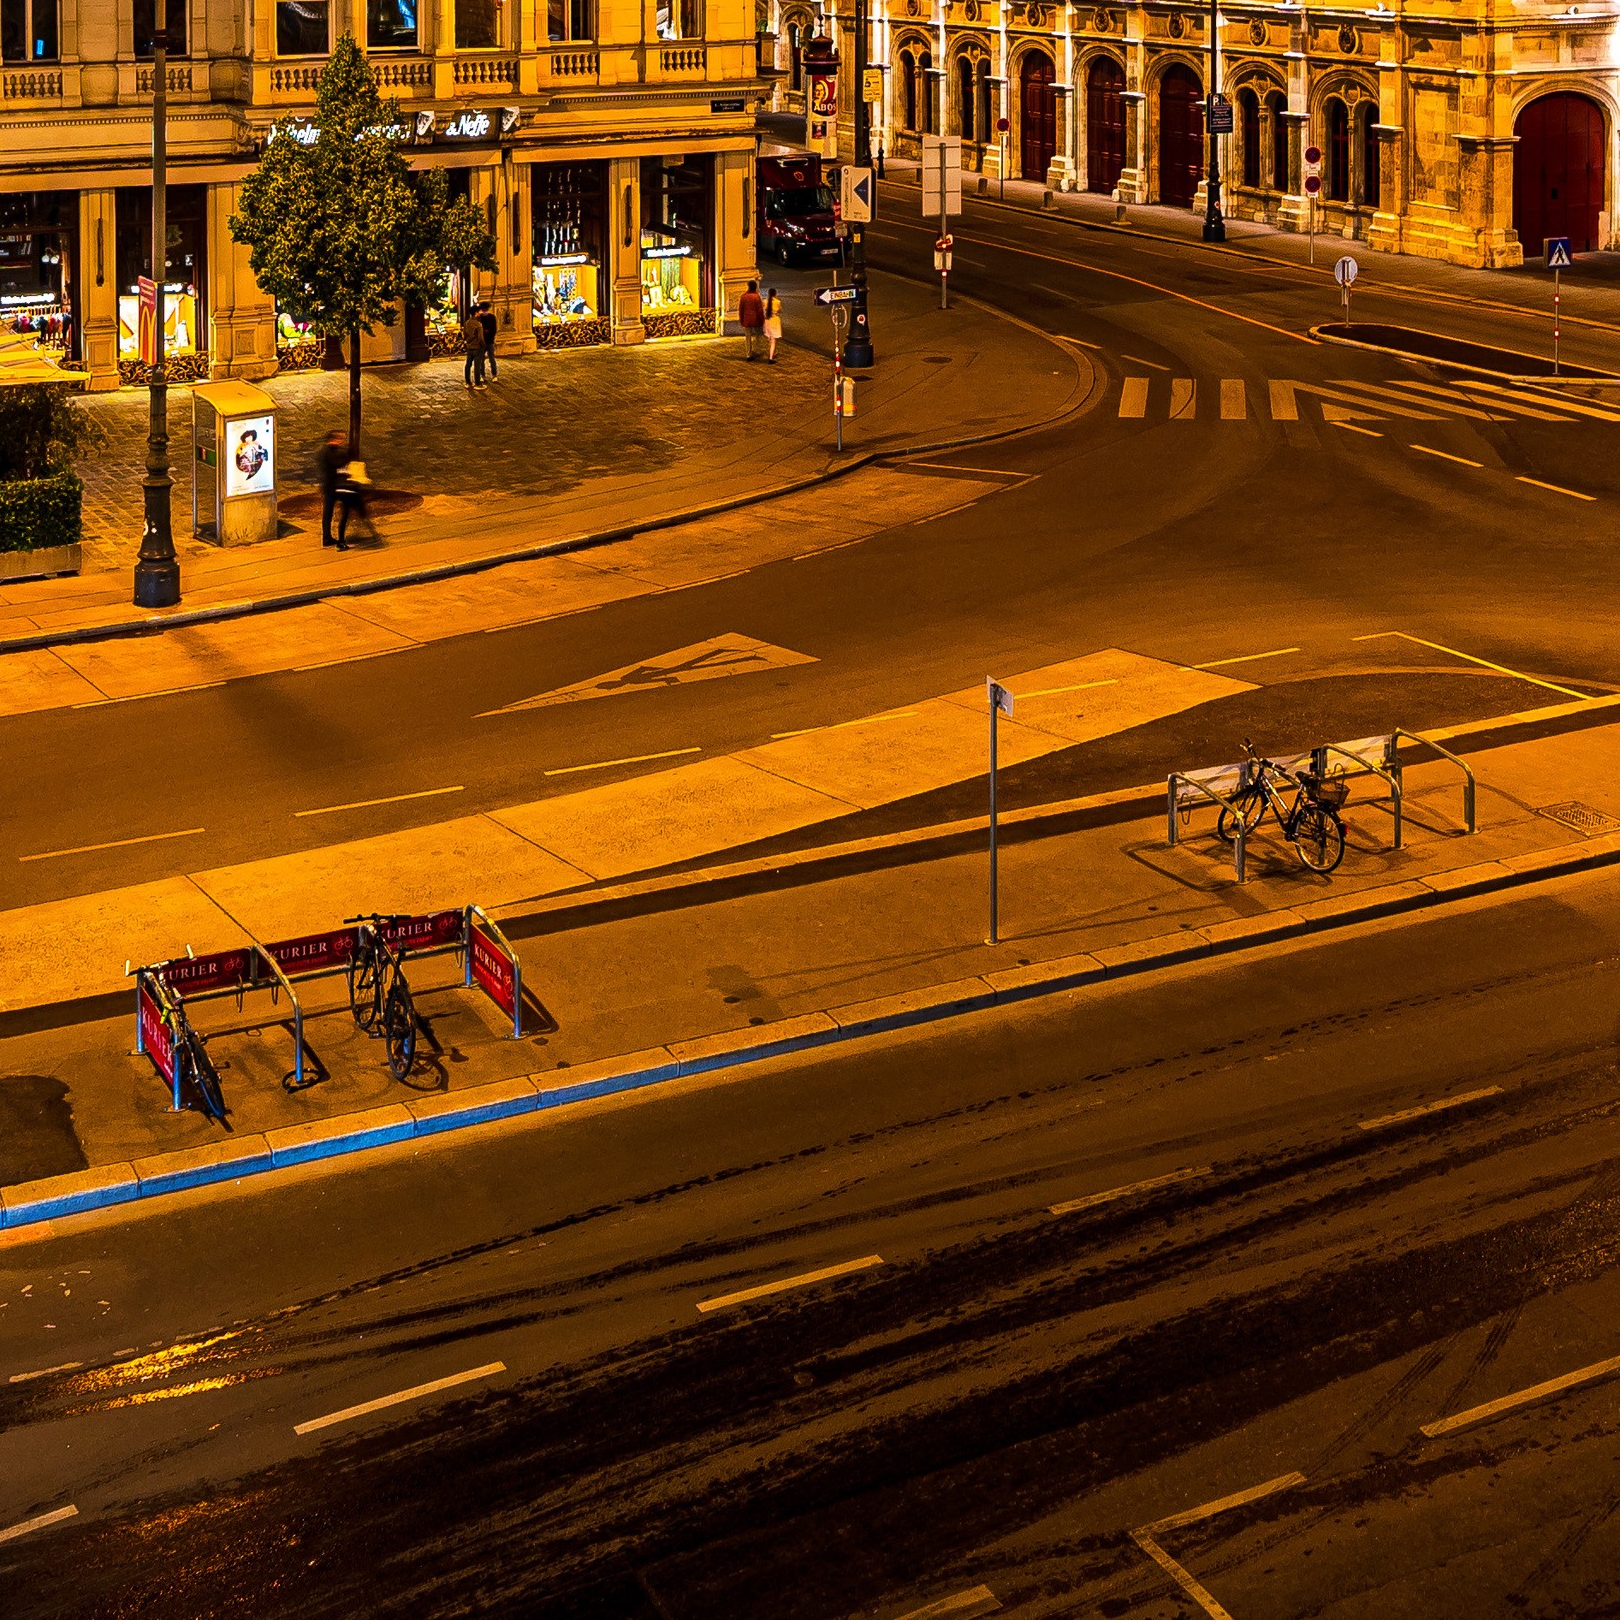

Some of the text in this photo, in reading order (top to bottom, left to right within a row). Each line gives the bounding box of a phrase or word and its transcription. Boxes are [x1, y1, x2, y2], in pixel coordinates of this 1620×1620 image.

[459, 115, 490, 137] Neffe
[381, 922, 433, 939] URIER
[165, 962, 218, 981] URIER
[474, 943, 502, 980] KURIER
